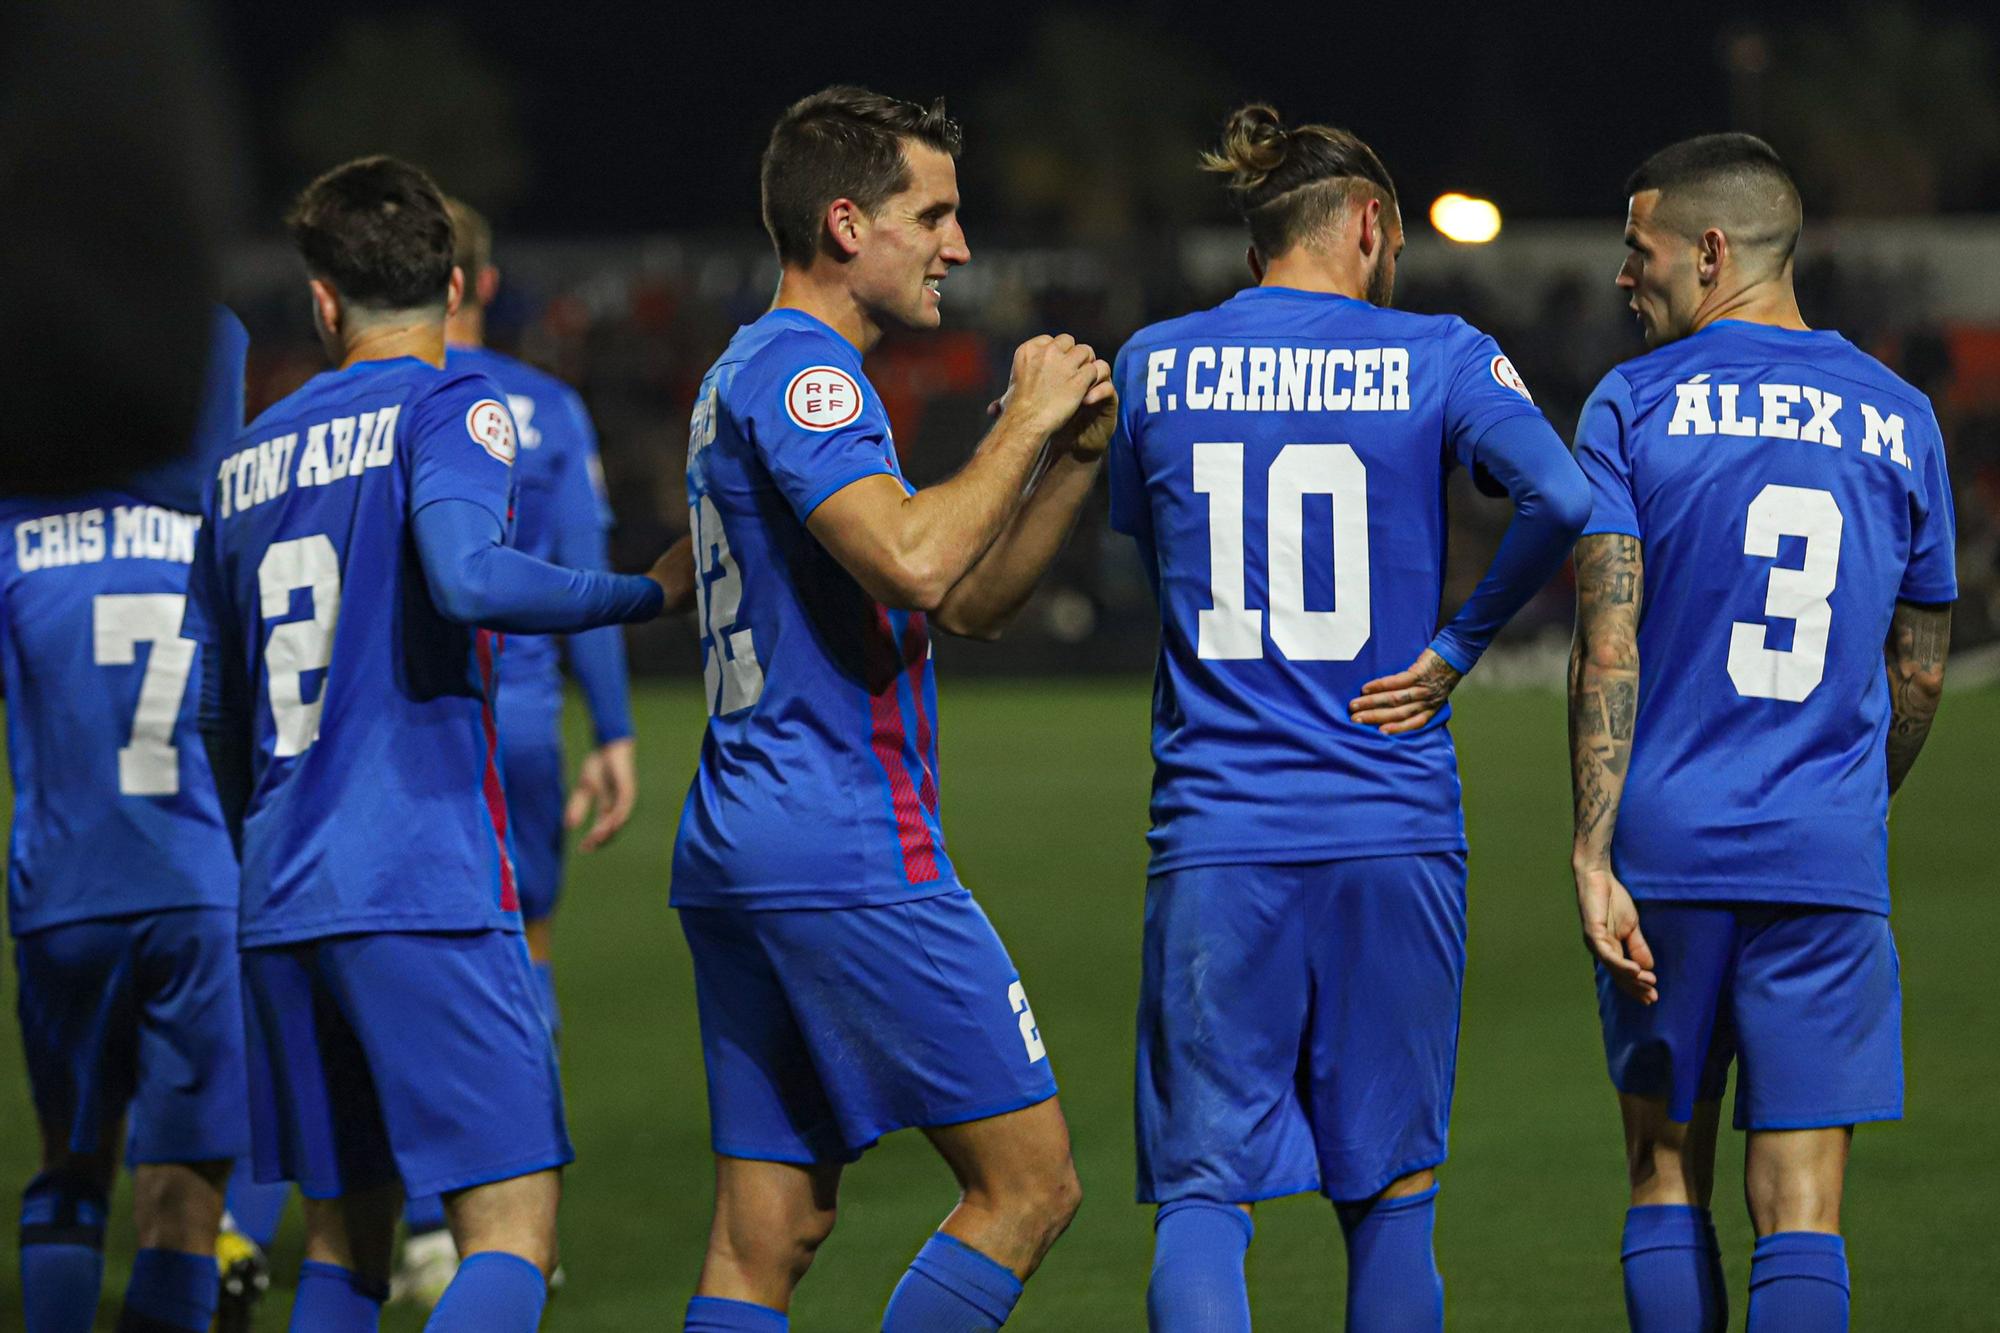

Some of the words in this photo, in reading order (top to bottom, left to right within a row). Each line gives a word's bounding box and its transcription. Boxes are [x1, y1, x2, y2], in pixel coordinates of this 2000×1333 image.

[1145, 348, 1176, 413] F.
[1185, 347, 1410, 412] CARNICER
[1668, 373, 1842, 448] ÁLEX
[15, 508, 105, 573] CRIS
[218, 432, 298, 519] TONI
[1192, 442, 1371, 661] 10
[1726, 483, 1843, 703] 3
[93, 593, 197, 795] 7
[258, 533, 341, 757] 2
